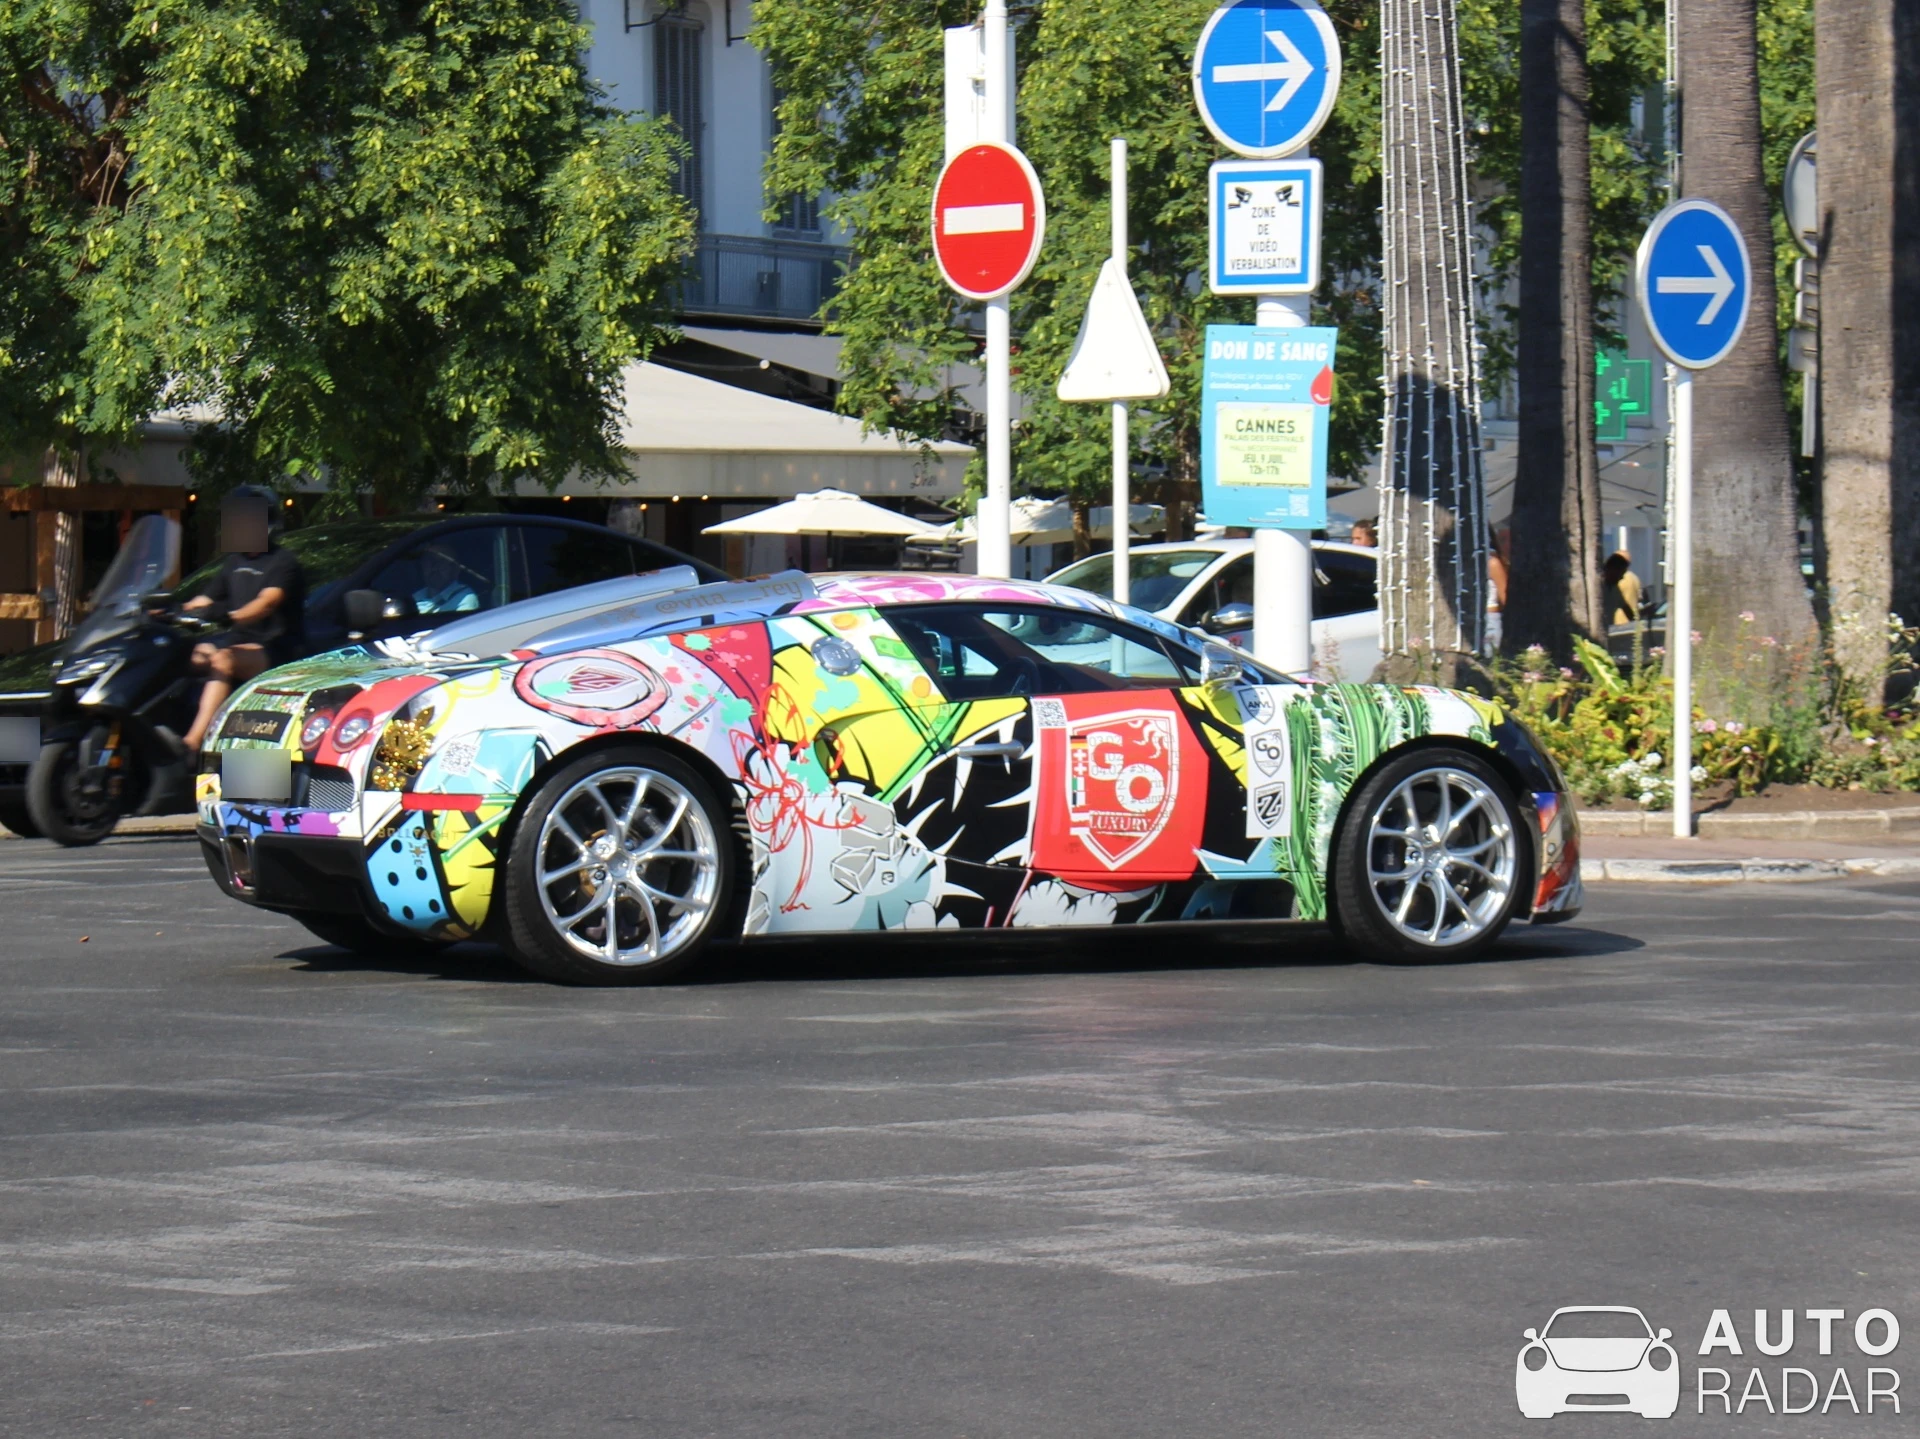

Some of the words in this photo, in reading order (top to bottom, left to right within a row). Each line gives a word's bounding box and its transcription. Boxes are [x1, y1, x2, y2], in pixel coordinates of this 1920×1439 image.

[1251, 206, 1276, 218] ZONE
[1258, 224, 1270, 235] DE
[1250, 239, 1278, 252] VIDÉO
[1230, 258, 1297, 270] VERBALISATION
[1210, 341, 1249, 360] DON
[1253, 341, 1276, 361] DE
[1281, 342, 1329, 361] SANG
[1235, 418, 1296, 434] CANNES
